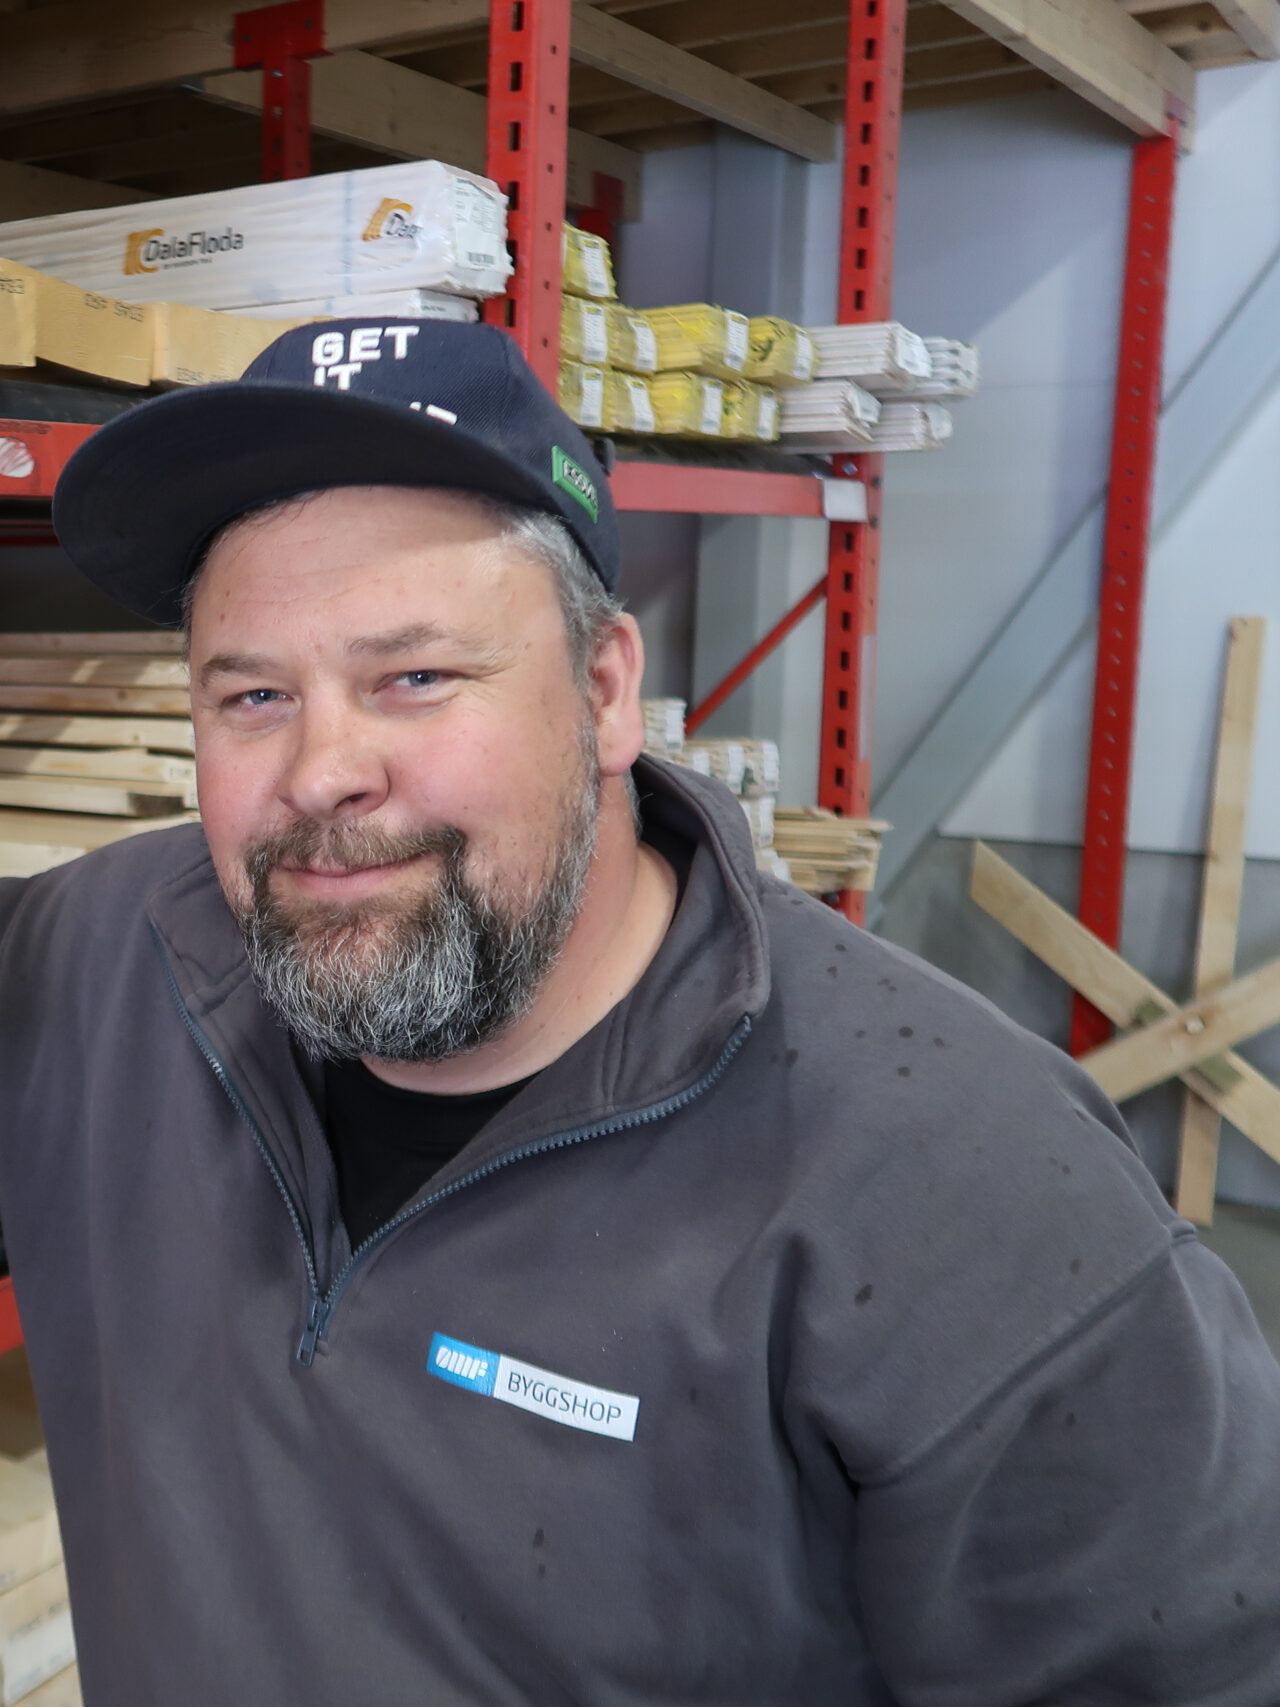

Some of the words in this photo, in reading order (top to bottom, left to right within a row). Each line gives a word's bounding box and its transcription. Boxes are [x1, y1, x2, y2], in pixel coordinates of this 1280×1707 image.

[144, 227, 244, 262] DalaFloda
[311, 325, 420, 367] GET
[313, 361, 363, 392] IT
[507, 1371, 622, 1425] BYGGSHOP
